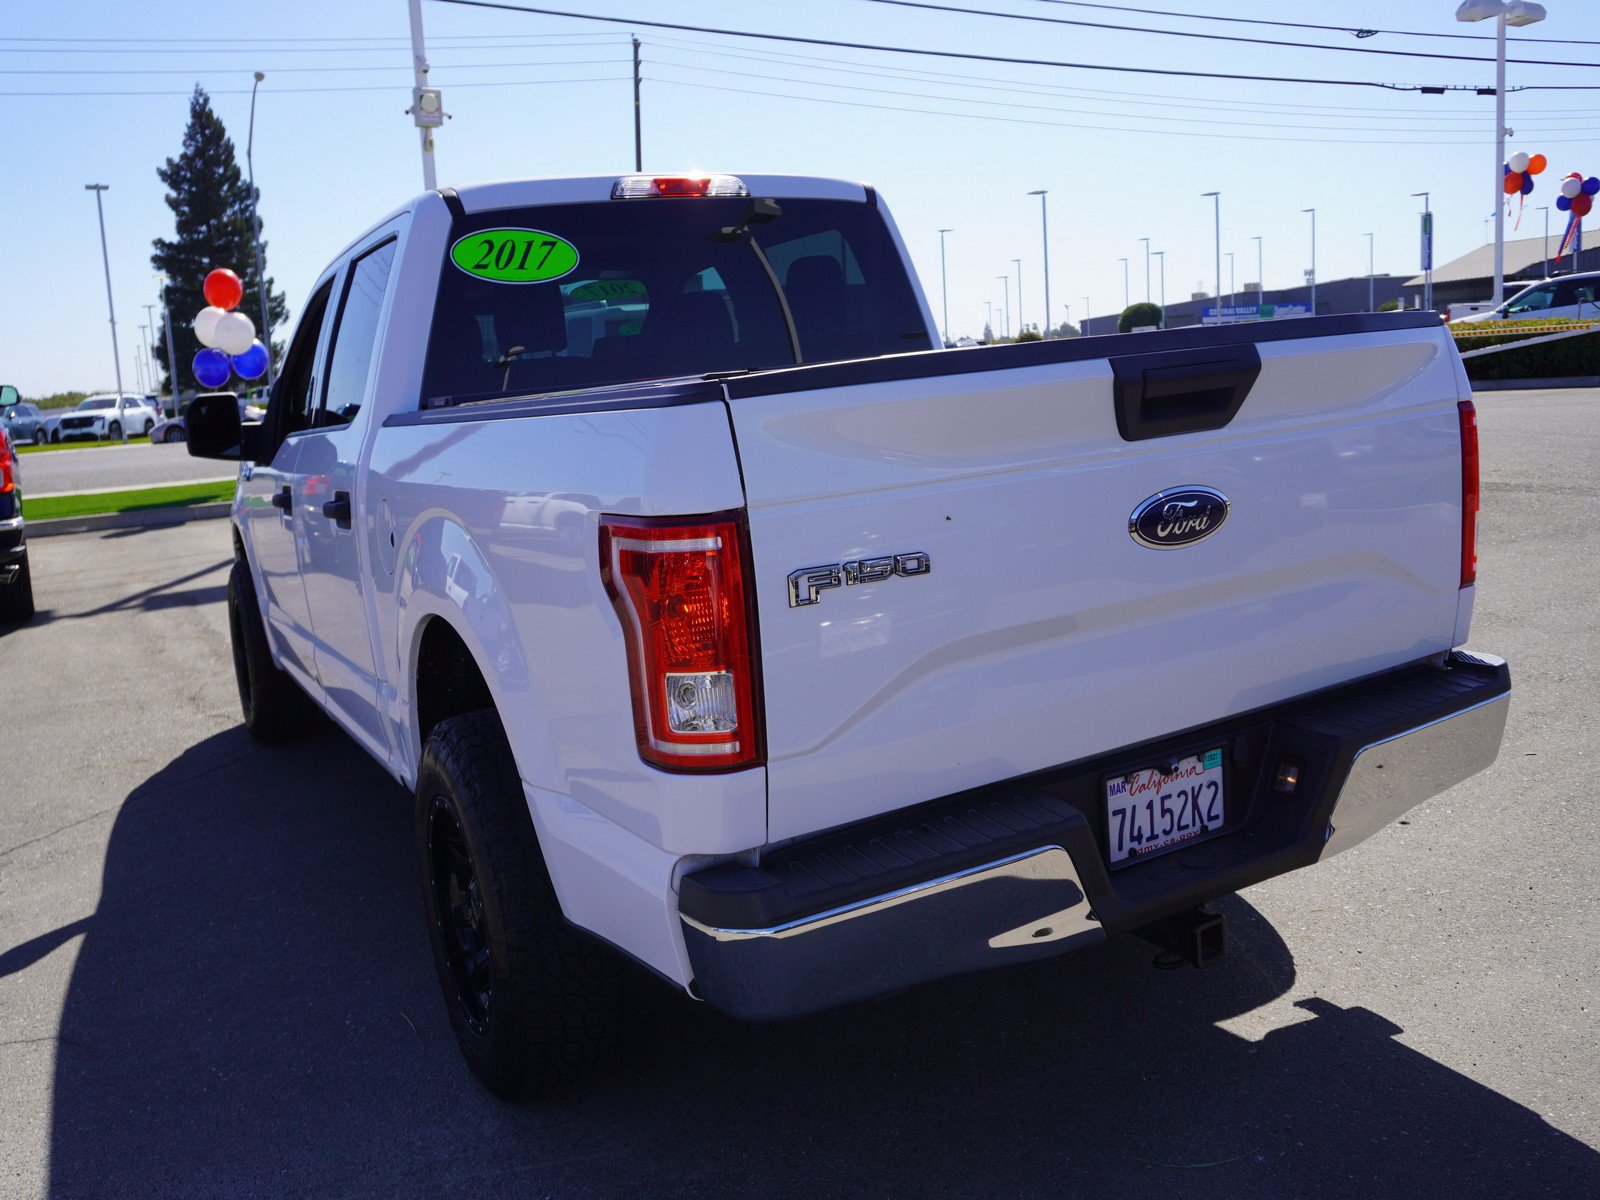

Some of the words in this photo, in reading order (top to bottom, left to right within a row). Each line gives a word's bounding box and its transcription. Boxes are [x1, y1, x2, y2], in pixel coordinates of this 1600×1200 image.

[472, 238, 558, 271] 2017
[1236, 306, 1257, 314] VALLEY
[1157, 500, 1211, 537] Ford
[787, 551, 931, 608] F150
[1109, 780, 1127, 797] MAR
[1129, 765, 1205, 796] California
[1112, 780, 1220, 852] 74152K2
